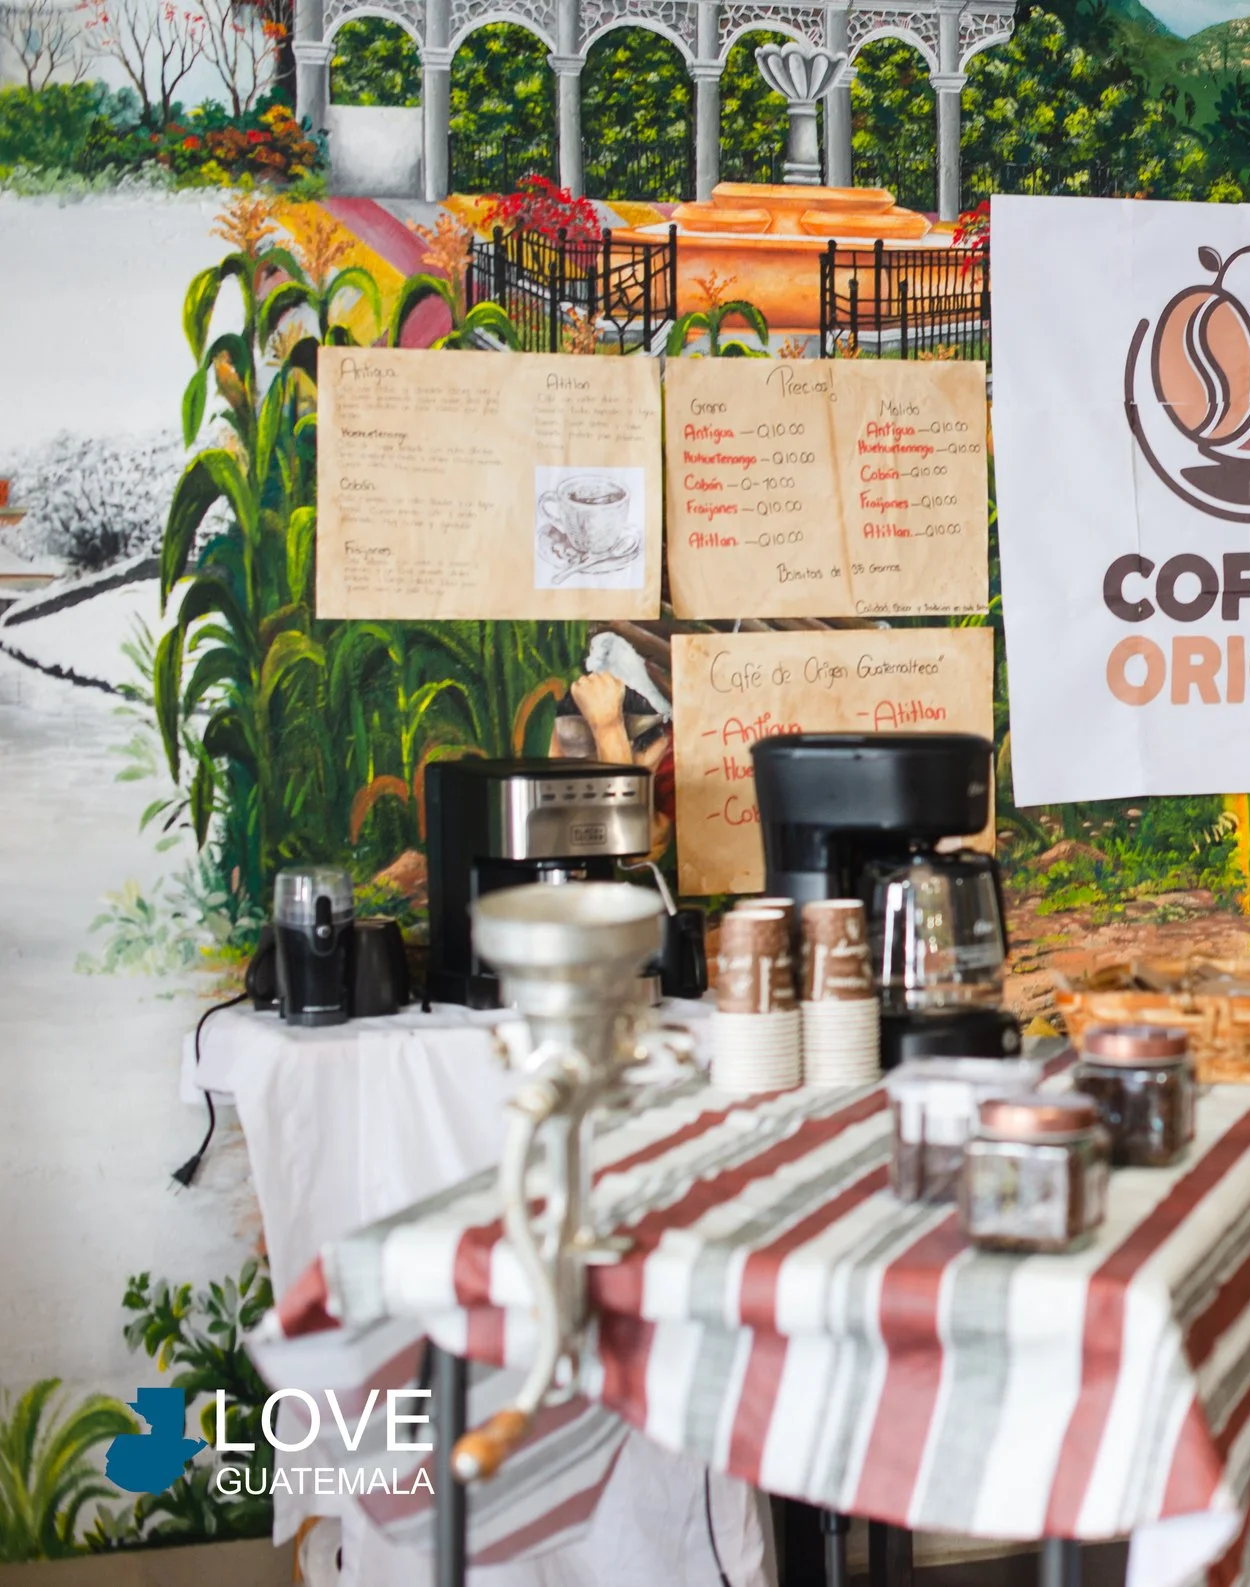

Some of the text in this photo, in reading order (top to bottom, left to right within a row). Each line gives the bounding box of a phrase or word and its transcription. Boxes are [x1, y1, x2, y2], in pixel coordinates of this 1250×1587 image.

[683, 423, 735, 445] Antigua
[866, 421, 915, 442] Antigua
[772, 661, 791, 685] de
[804, 656, 848, 689] Origen
